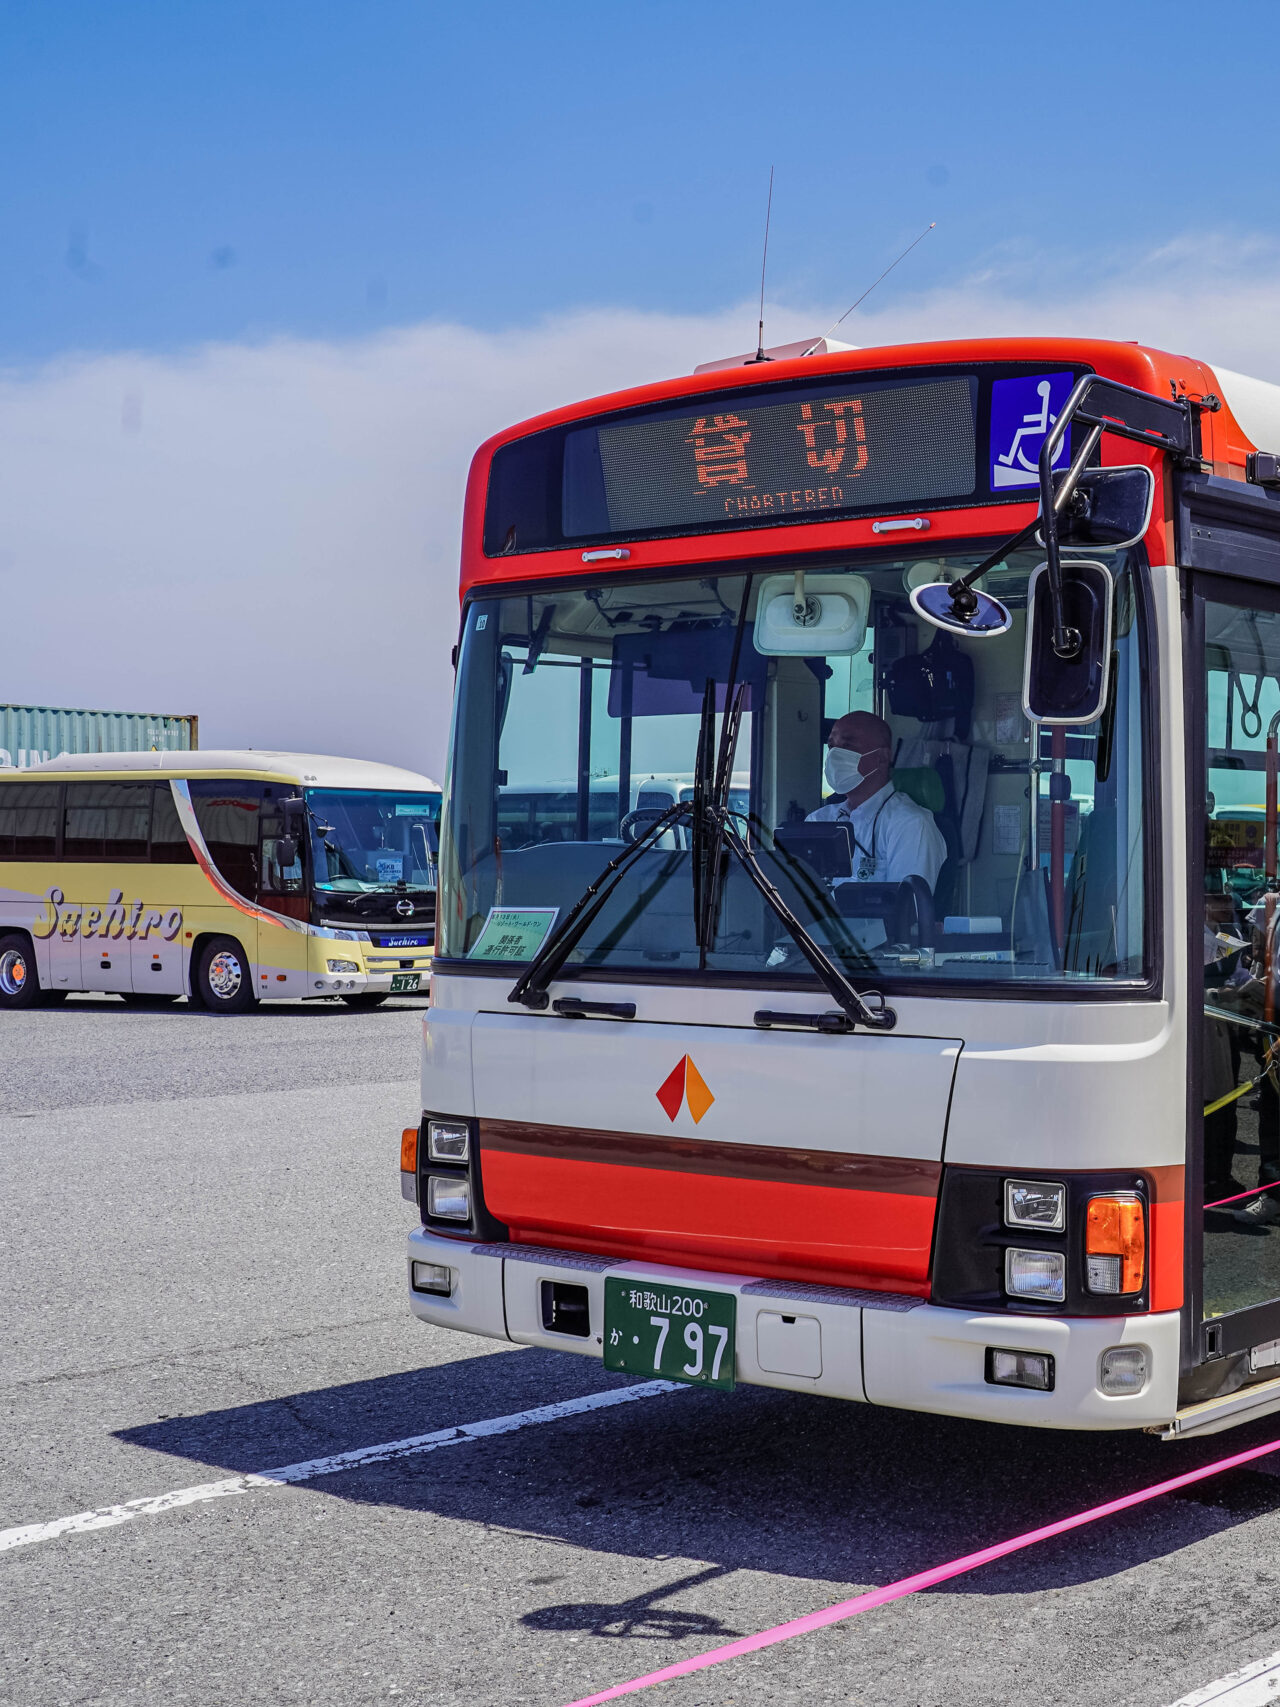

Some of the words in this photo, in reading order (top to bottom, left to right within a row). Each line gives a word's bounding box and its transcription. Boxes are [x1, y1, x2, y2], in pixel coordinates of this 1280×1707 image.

[684, 400, 869, 494] 貸切
[724, 486, 843, 518] CHARTERED
[32, 885, 184, 942] Suehiro
[388, 936, 420, 947] Suehiro
[484, 944, 527, 957] 通行許可証
[499, 935, 523, 945] 関係者
[629, 1289, 704, 1318] 和歌山200
[609, 1327, 623, 1346] か
